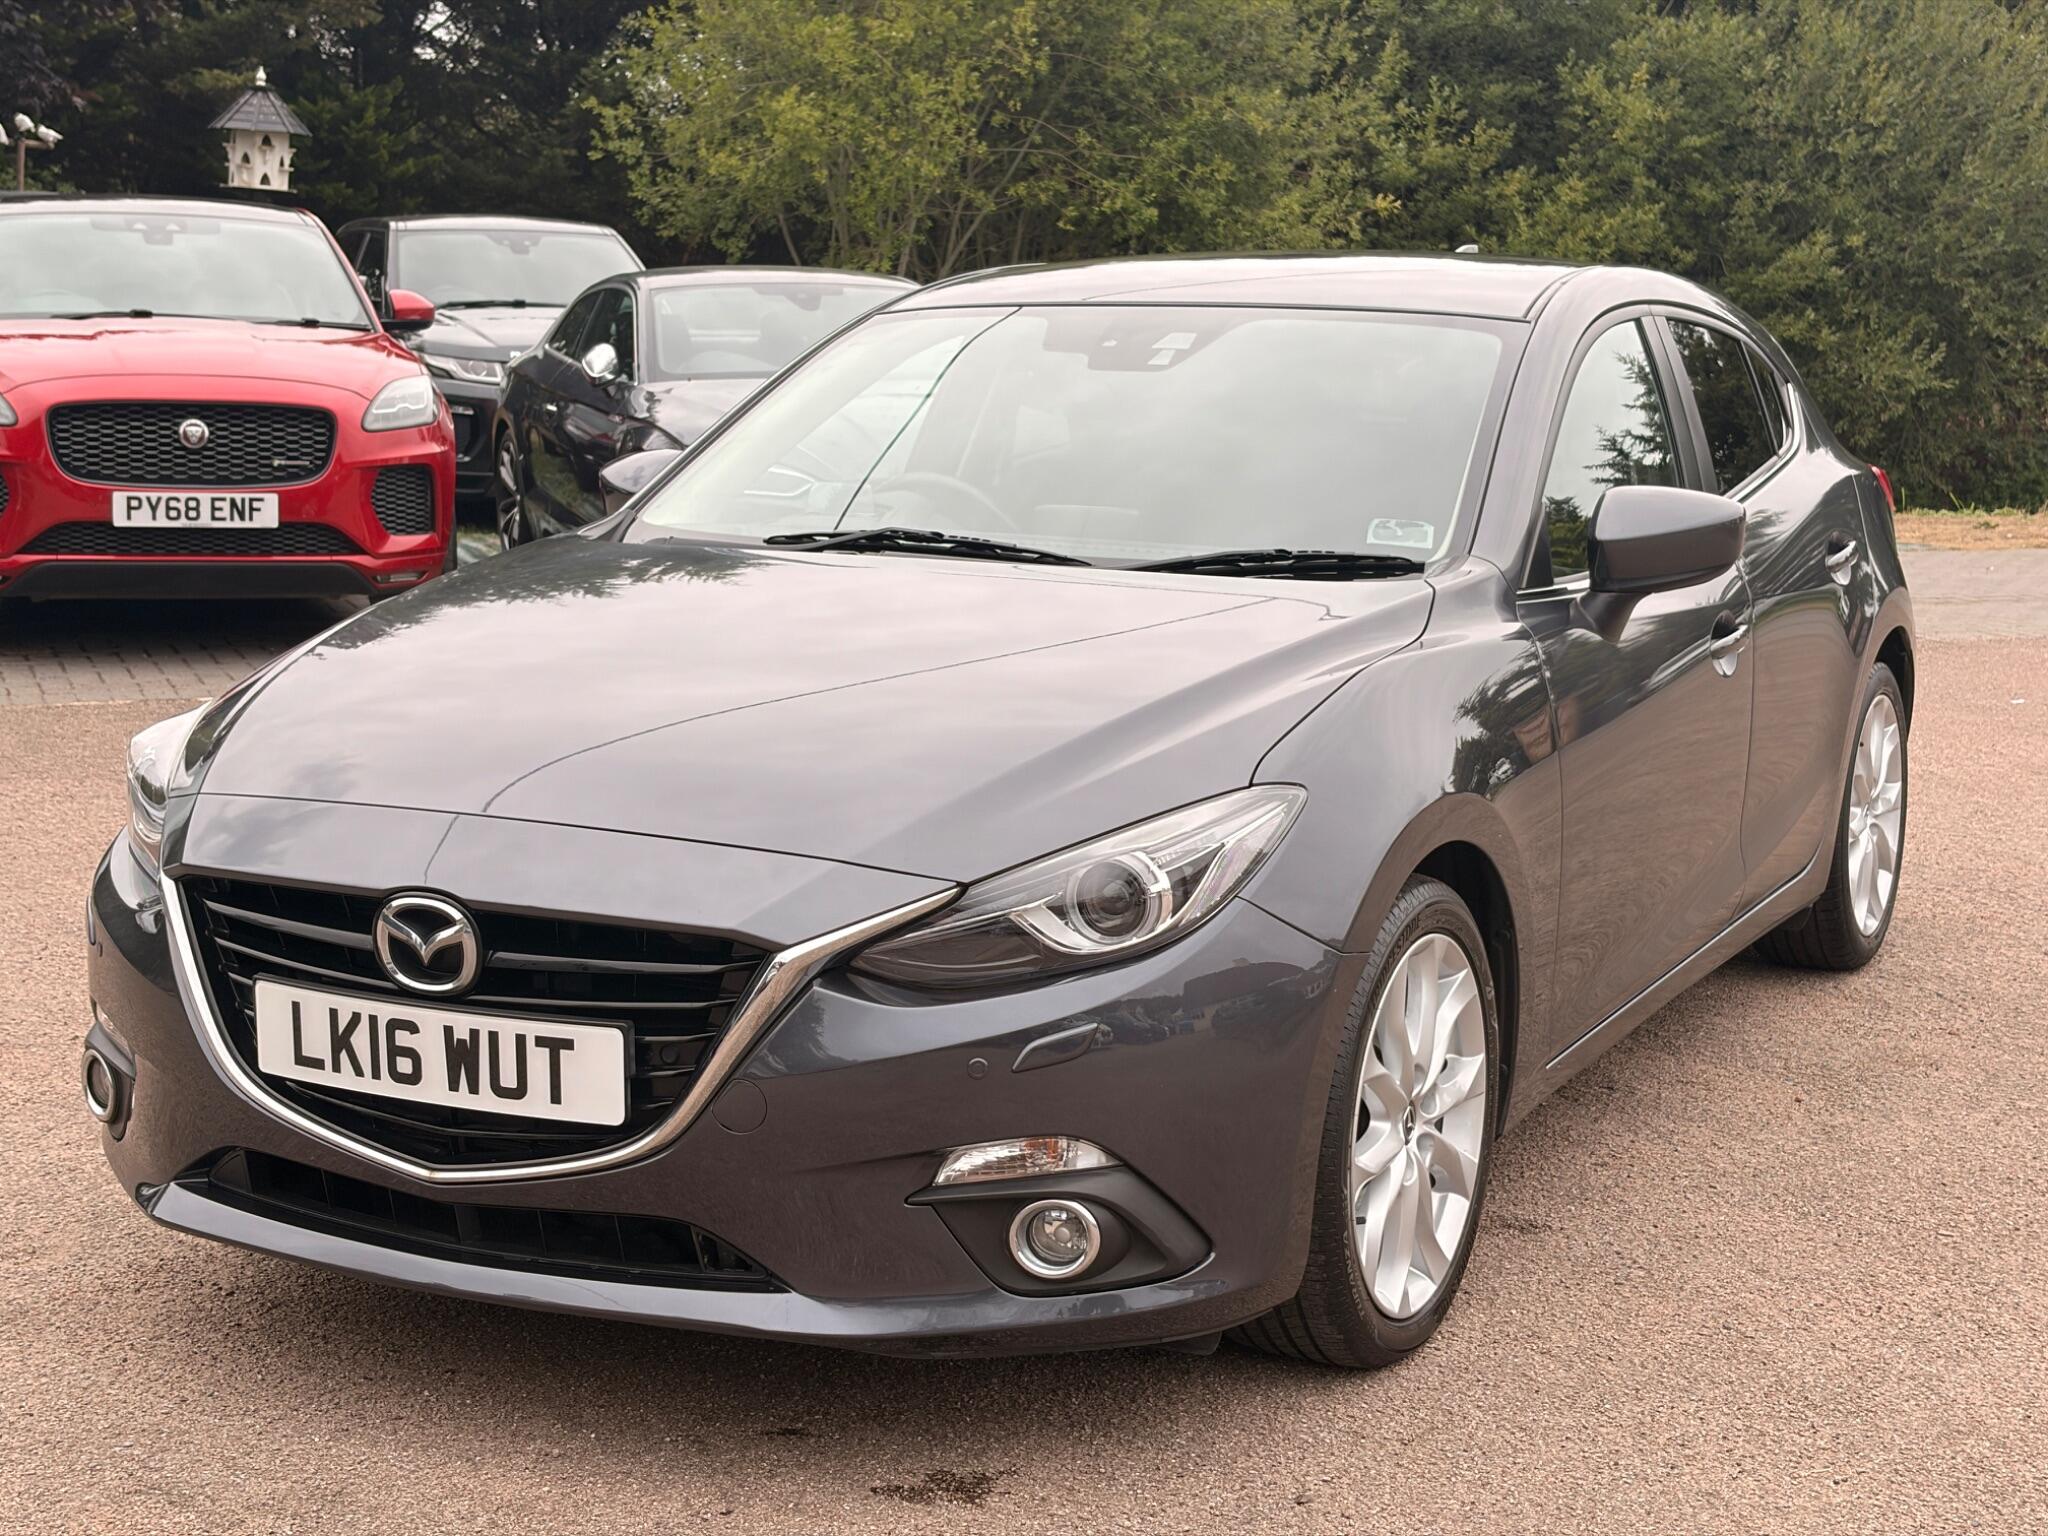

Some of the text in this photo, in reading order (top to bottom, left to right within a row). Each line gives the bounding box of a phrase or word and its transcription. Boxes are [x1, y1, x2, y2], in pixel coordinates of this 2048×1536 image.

[126, 496, 265, 522] PY68 ENF
[291, 1000, 575, 1105] LK16 WUT
